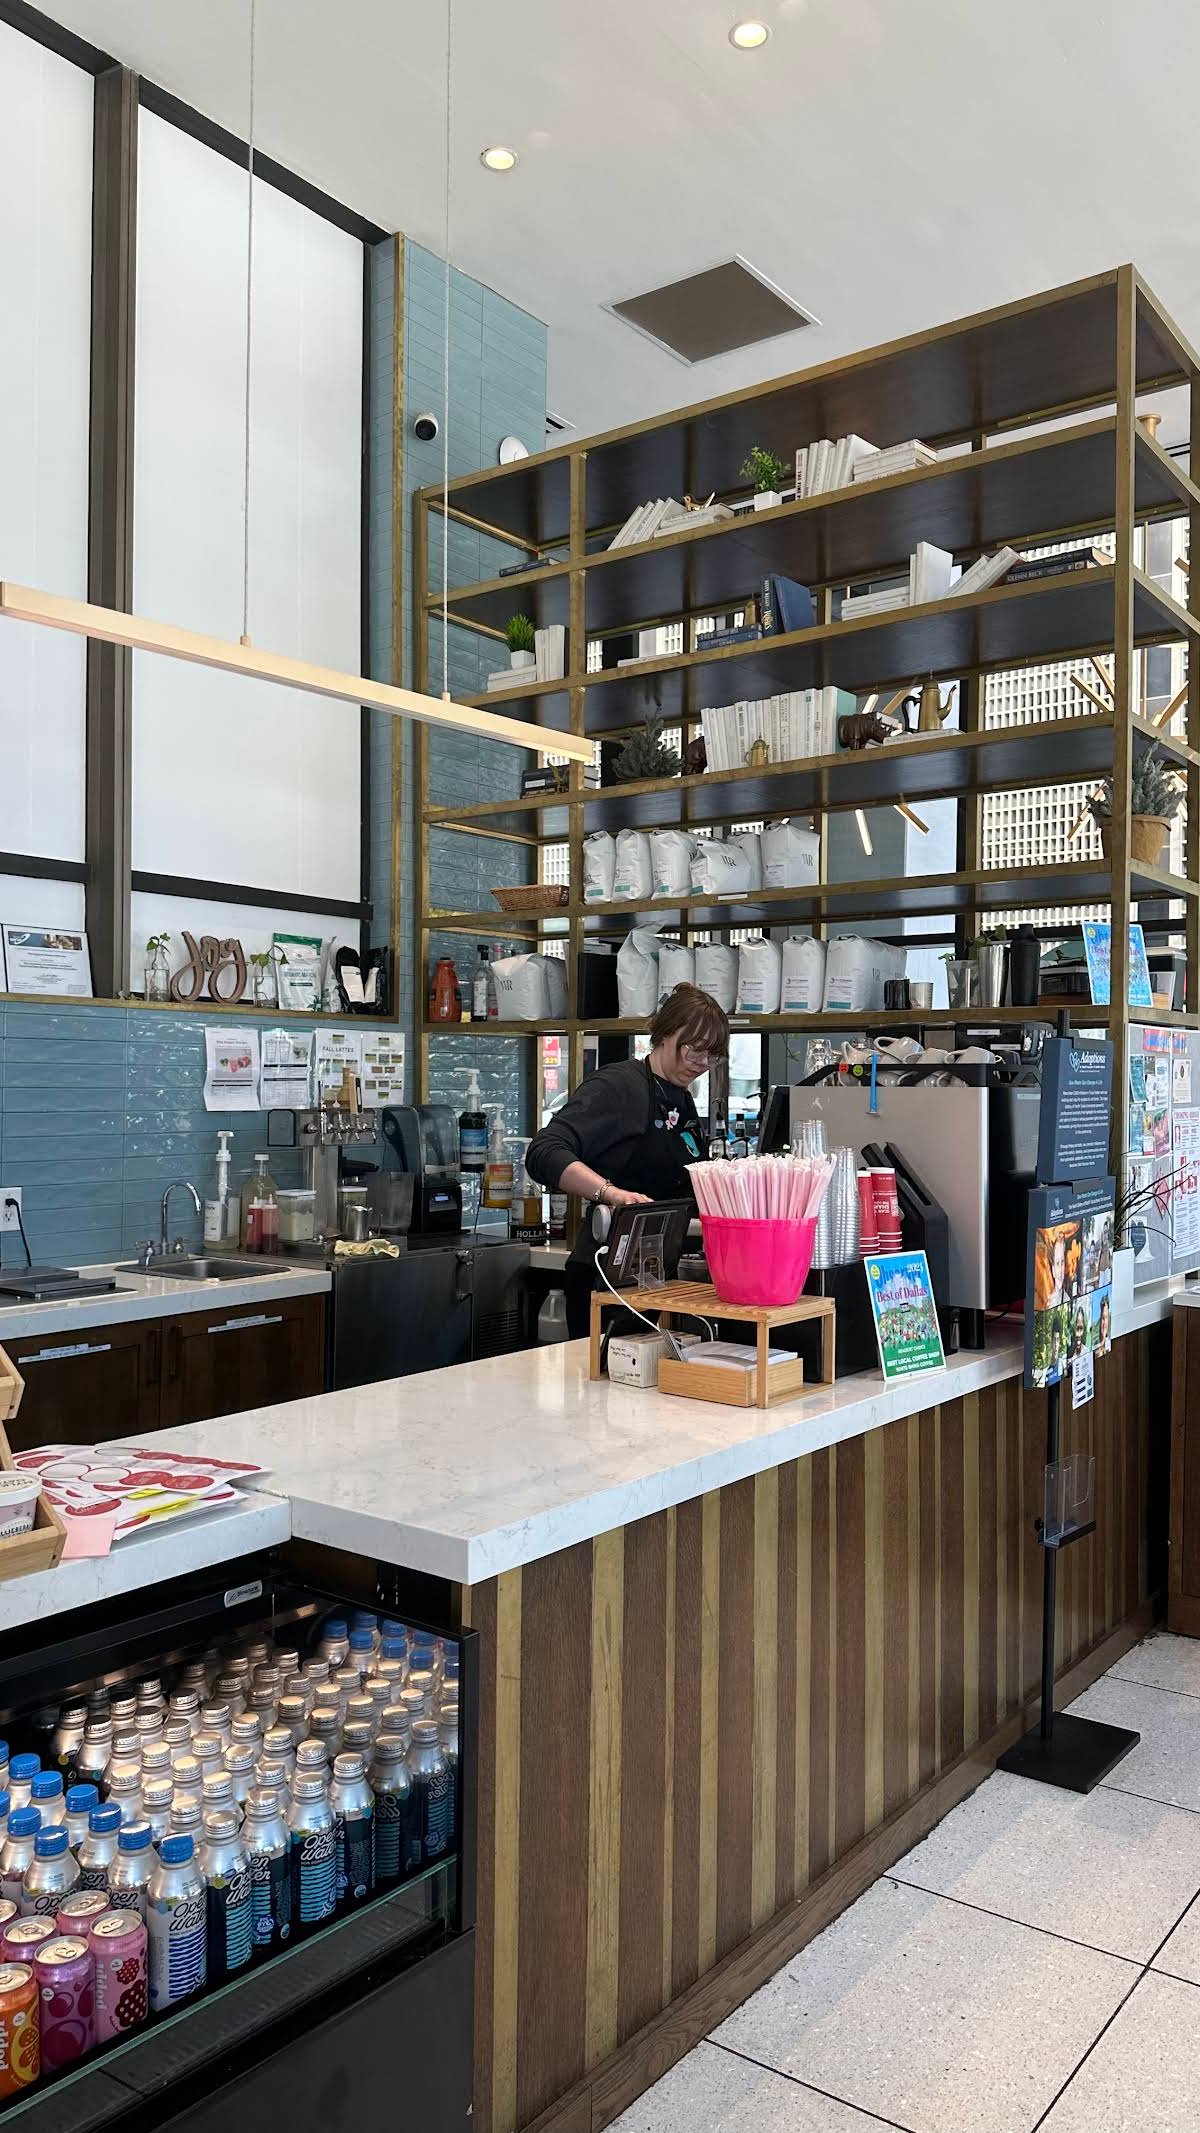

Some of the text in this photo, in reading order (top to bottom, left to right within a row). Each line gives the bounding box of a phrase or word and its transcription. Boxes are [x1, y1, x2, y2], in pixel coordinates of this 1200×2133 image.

[1007, 573, 1028, 582] GLENN
[1080, 1051, 1106, 1065] Adoptions
[876, 1285, 927, 1302] Best of Dallas
[912, 1354, 928, 1362] COFFEE
